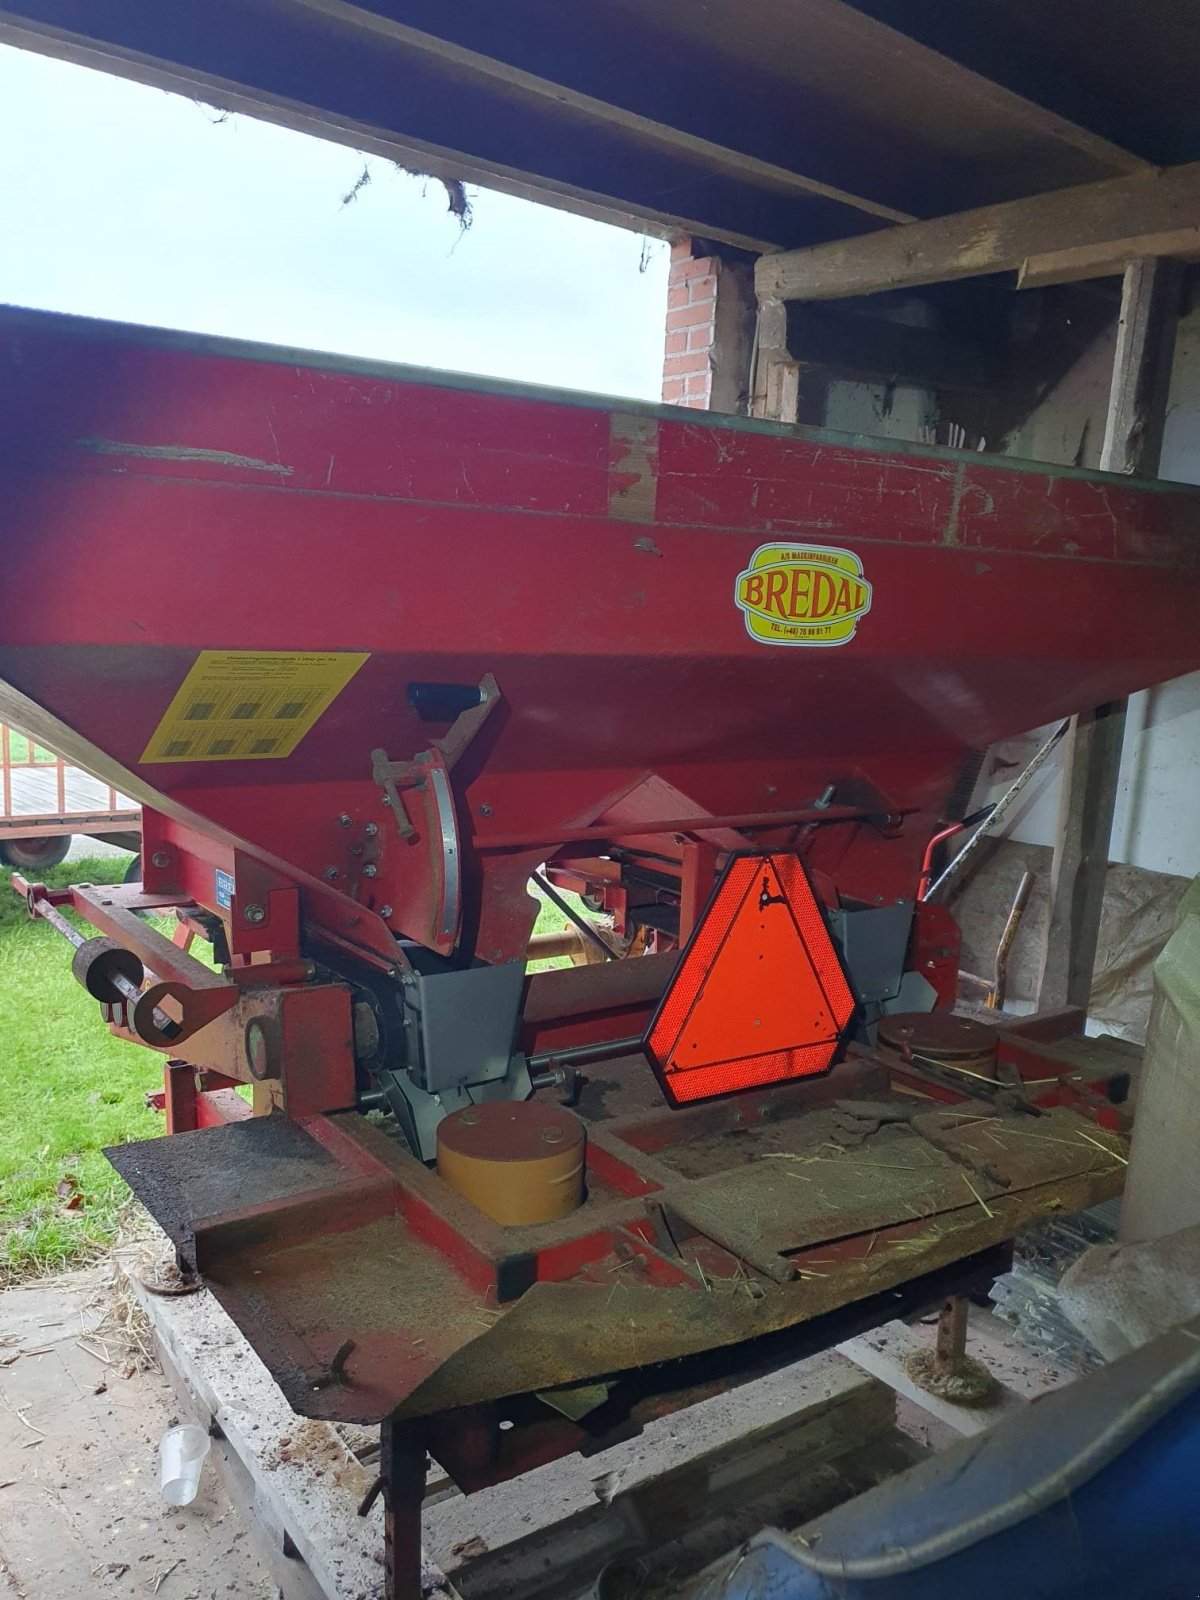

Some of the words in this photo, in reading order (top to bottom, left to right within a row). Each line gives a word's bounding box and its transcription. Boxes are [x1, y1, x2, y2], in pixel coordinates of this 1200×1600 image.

[743, 569, 865, 619] BREDAL
[771, 622, 782, 633] TEL.
[824, 626, 832, 635] 77
